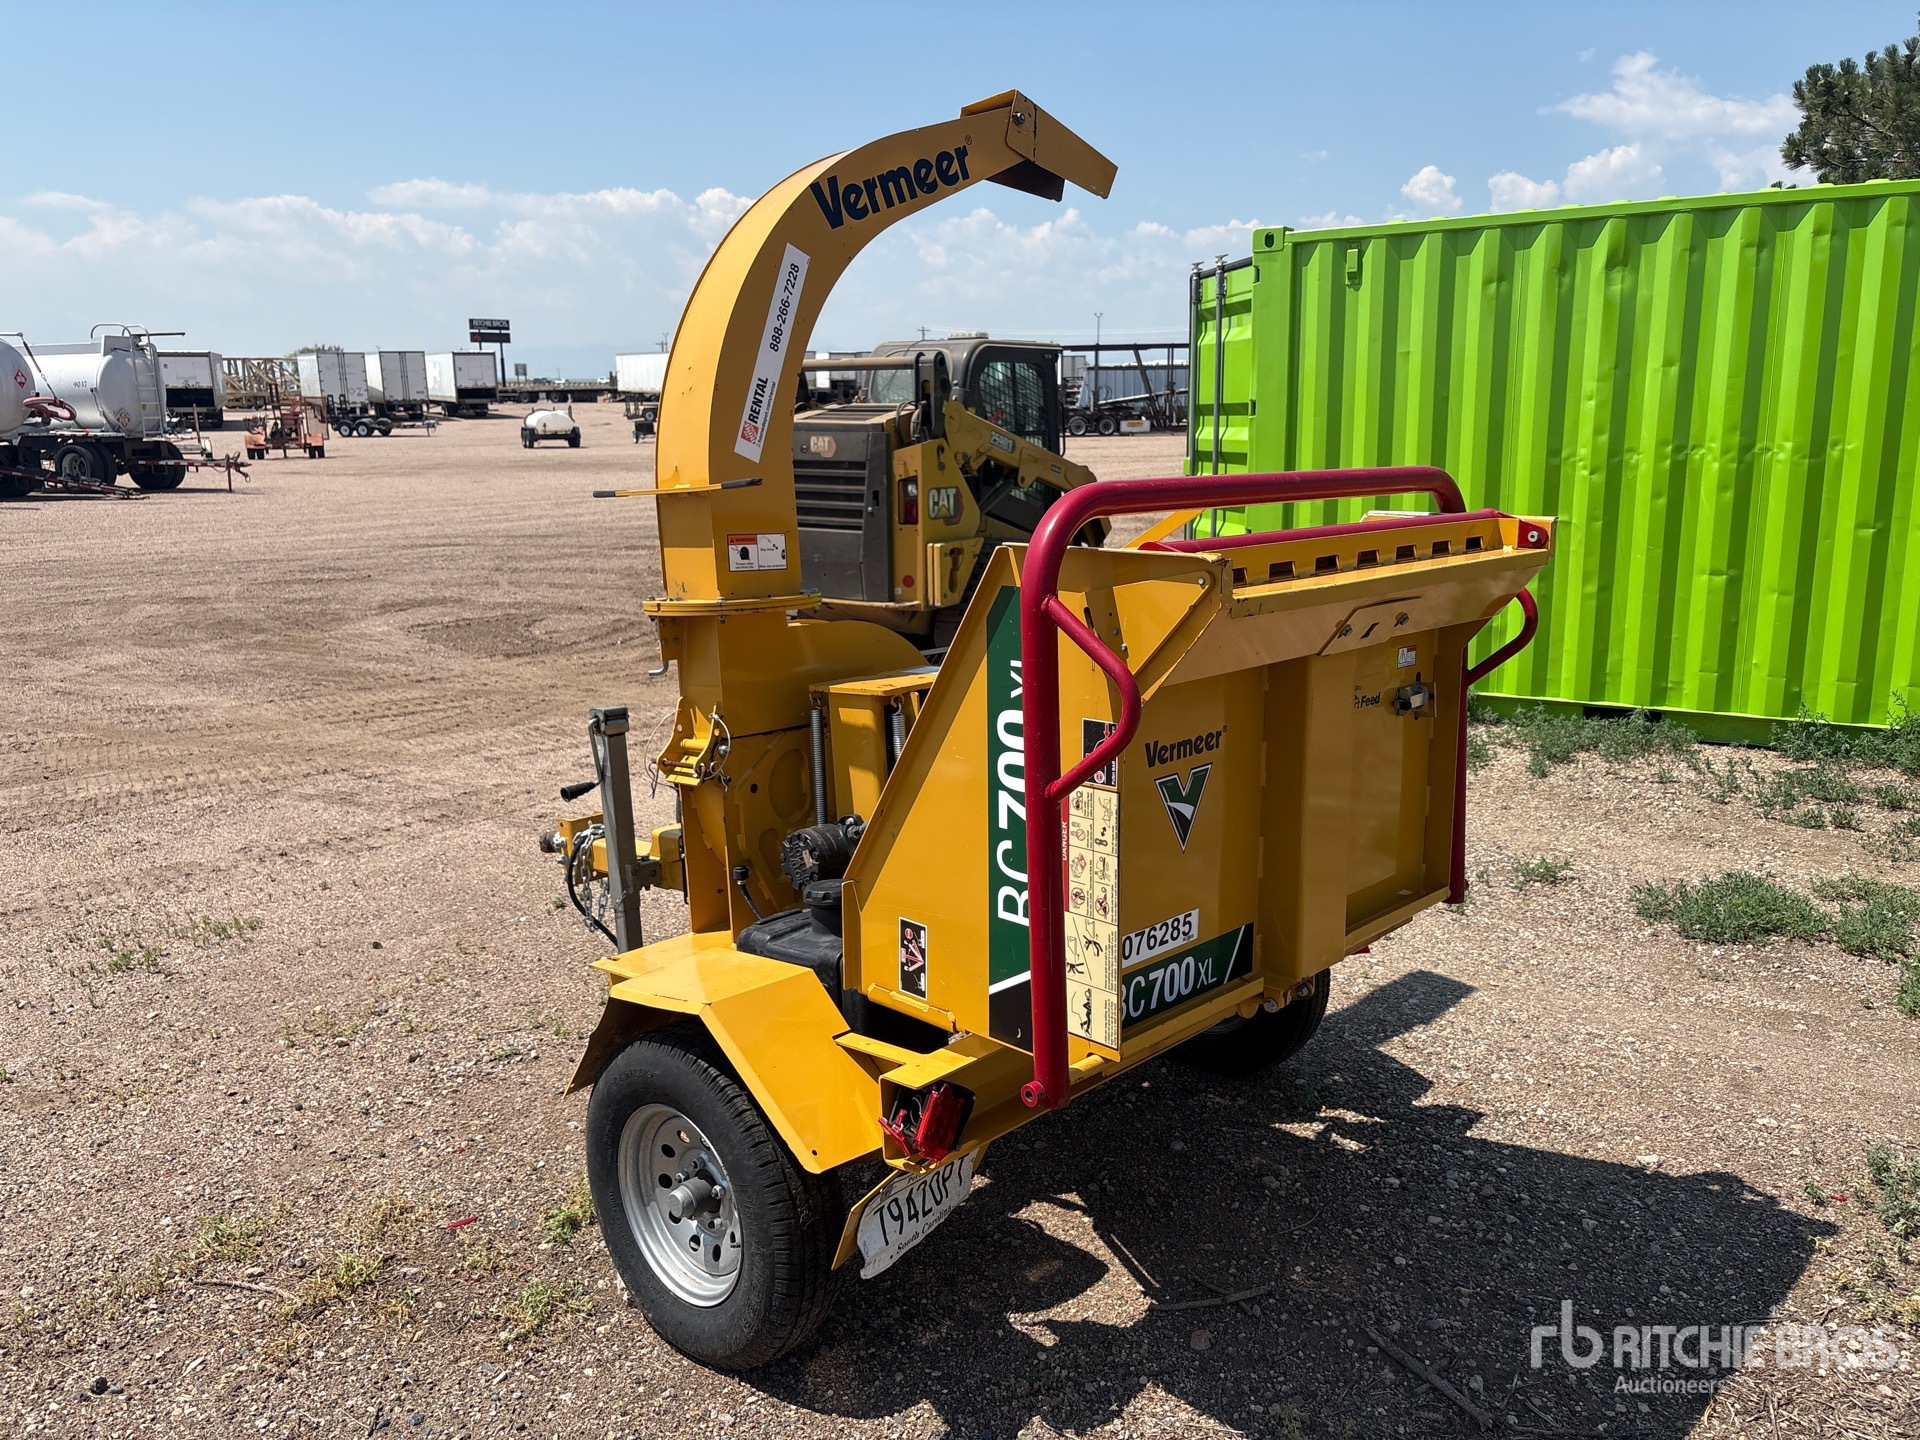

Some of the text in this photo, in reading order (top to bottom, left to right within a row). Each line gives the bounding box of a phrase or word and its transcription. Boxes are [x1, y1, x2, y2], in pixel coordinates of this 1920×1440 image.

[809, 144, 970, 230] Vermeer
[769, 263, 800, 353] 888-266-7228
[748, 377, 769, 425] RENTAL
[757, 381, 776, 444] homedepot.com/rental
[810, 435, 831, 453] CAT
[928, 487, 957, 519] CAT
[1144, 730, 1222, 768] Vermeer
[1122, 912, 1192, 960] 076285
[1149, 956, 1195, 1010] 700
[1197, 957, 1217, 989] XL
[897, 1204, 952, 1254] South Carolina
